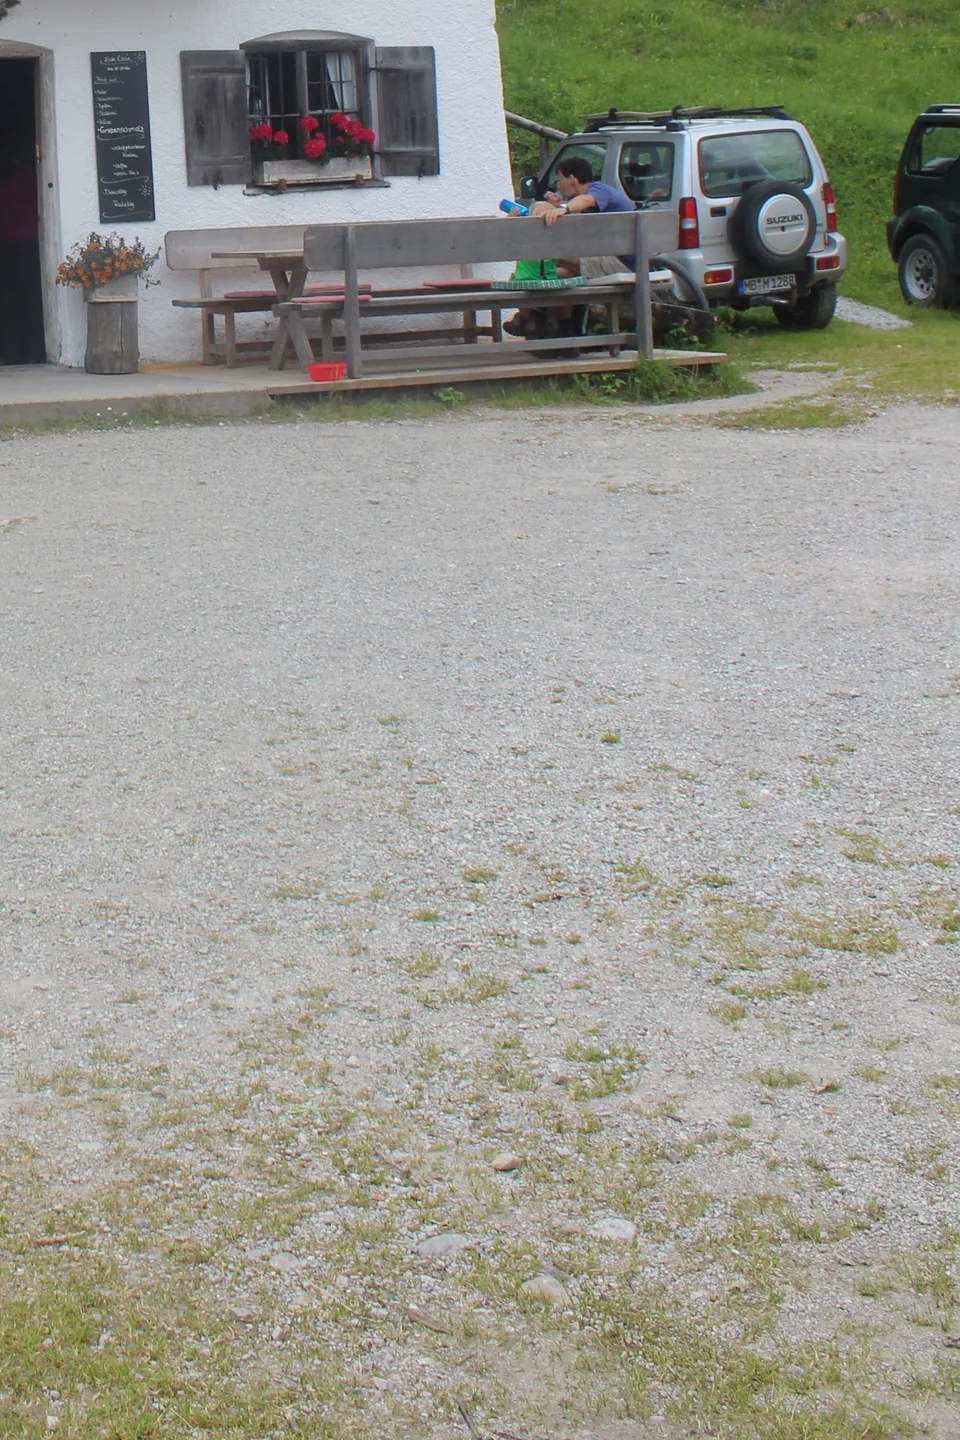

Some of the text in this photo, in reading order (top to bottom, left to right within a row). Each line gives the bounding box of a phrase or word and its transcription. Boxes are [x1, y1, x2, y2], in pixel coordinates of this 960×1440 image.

[100, 125, 144, 134] Griebenschmalz
[766, 214, 803, 225] SUZUKI
[771, 275, 794, 289] 1288
